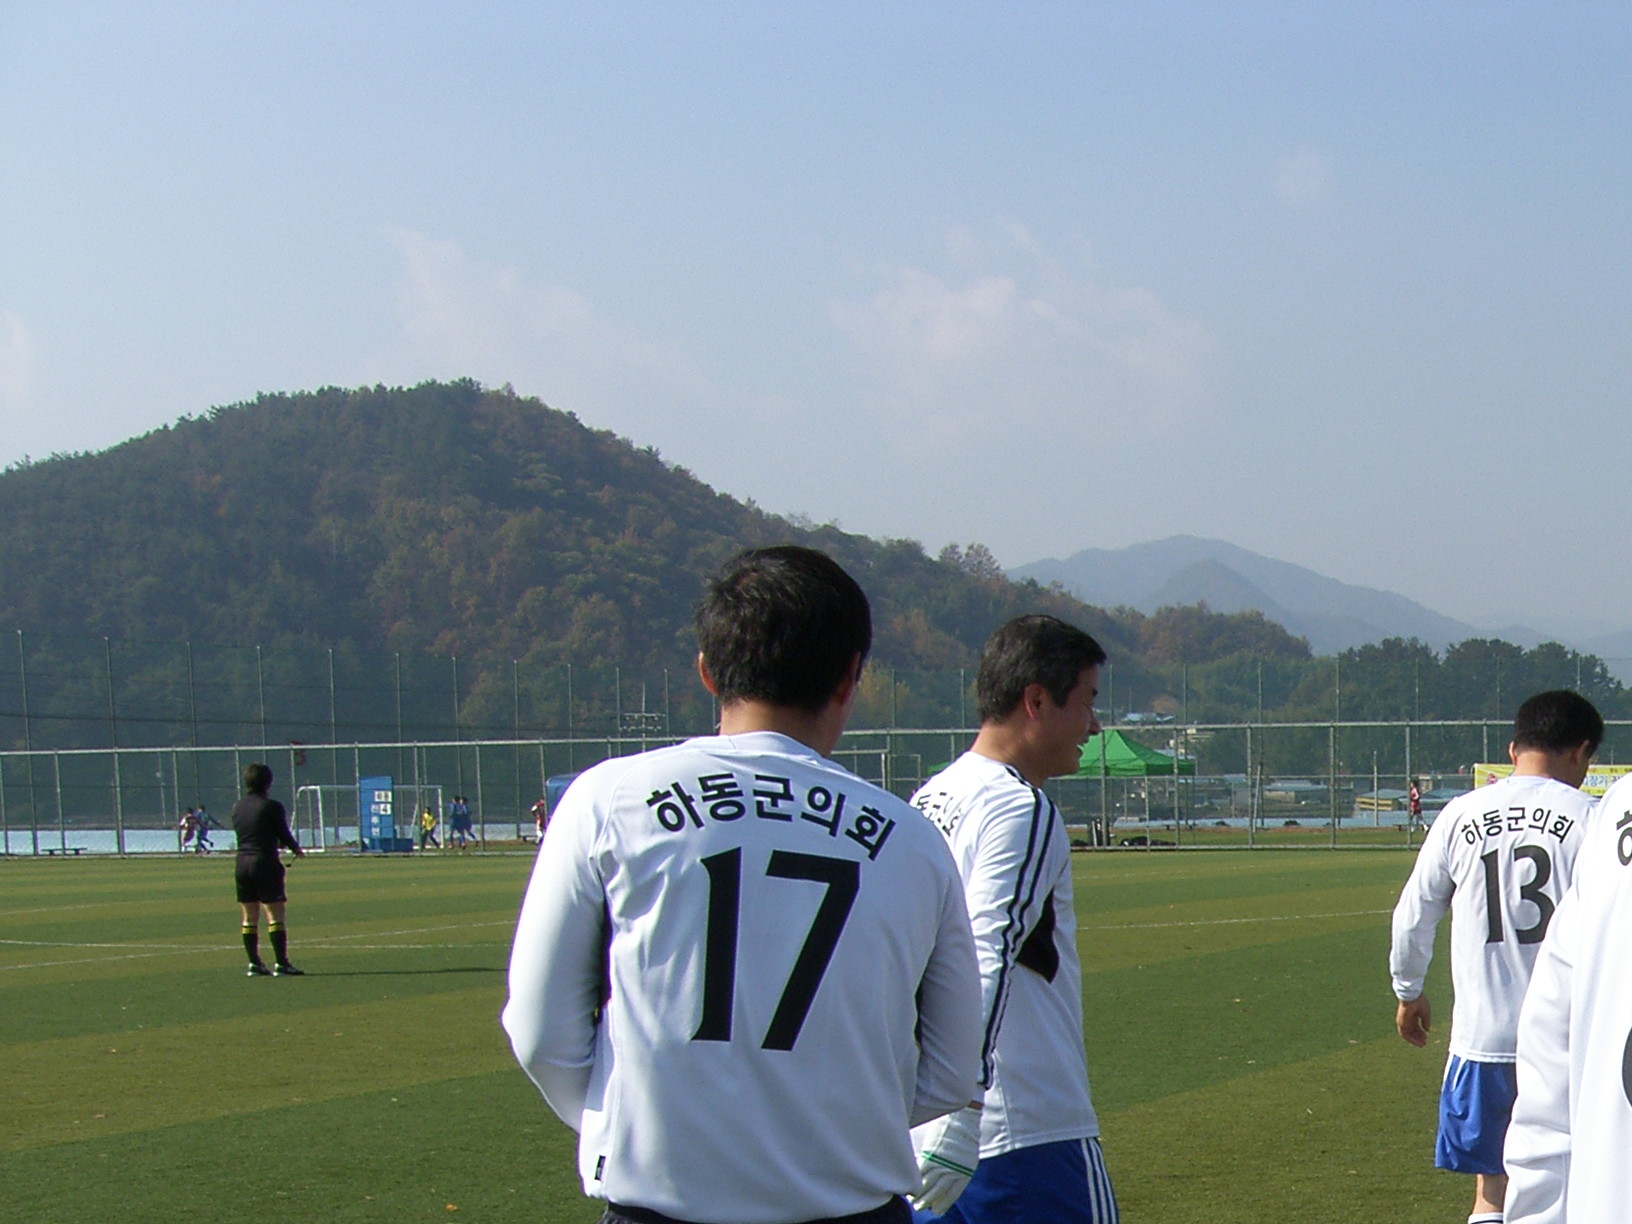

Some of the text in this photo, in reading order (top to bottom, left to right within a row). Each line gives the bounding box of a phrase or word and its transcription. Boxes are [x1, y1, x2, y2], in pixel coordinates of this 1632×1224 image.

[647, 773, 896, 861] 하동군의회
[1460, 807, 1574, 845] 하동군의회
[1480, 844, 1555, 944] 13
[691, 846, 861, 1051] 17
